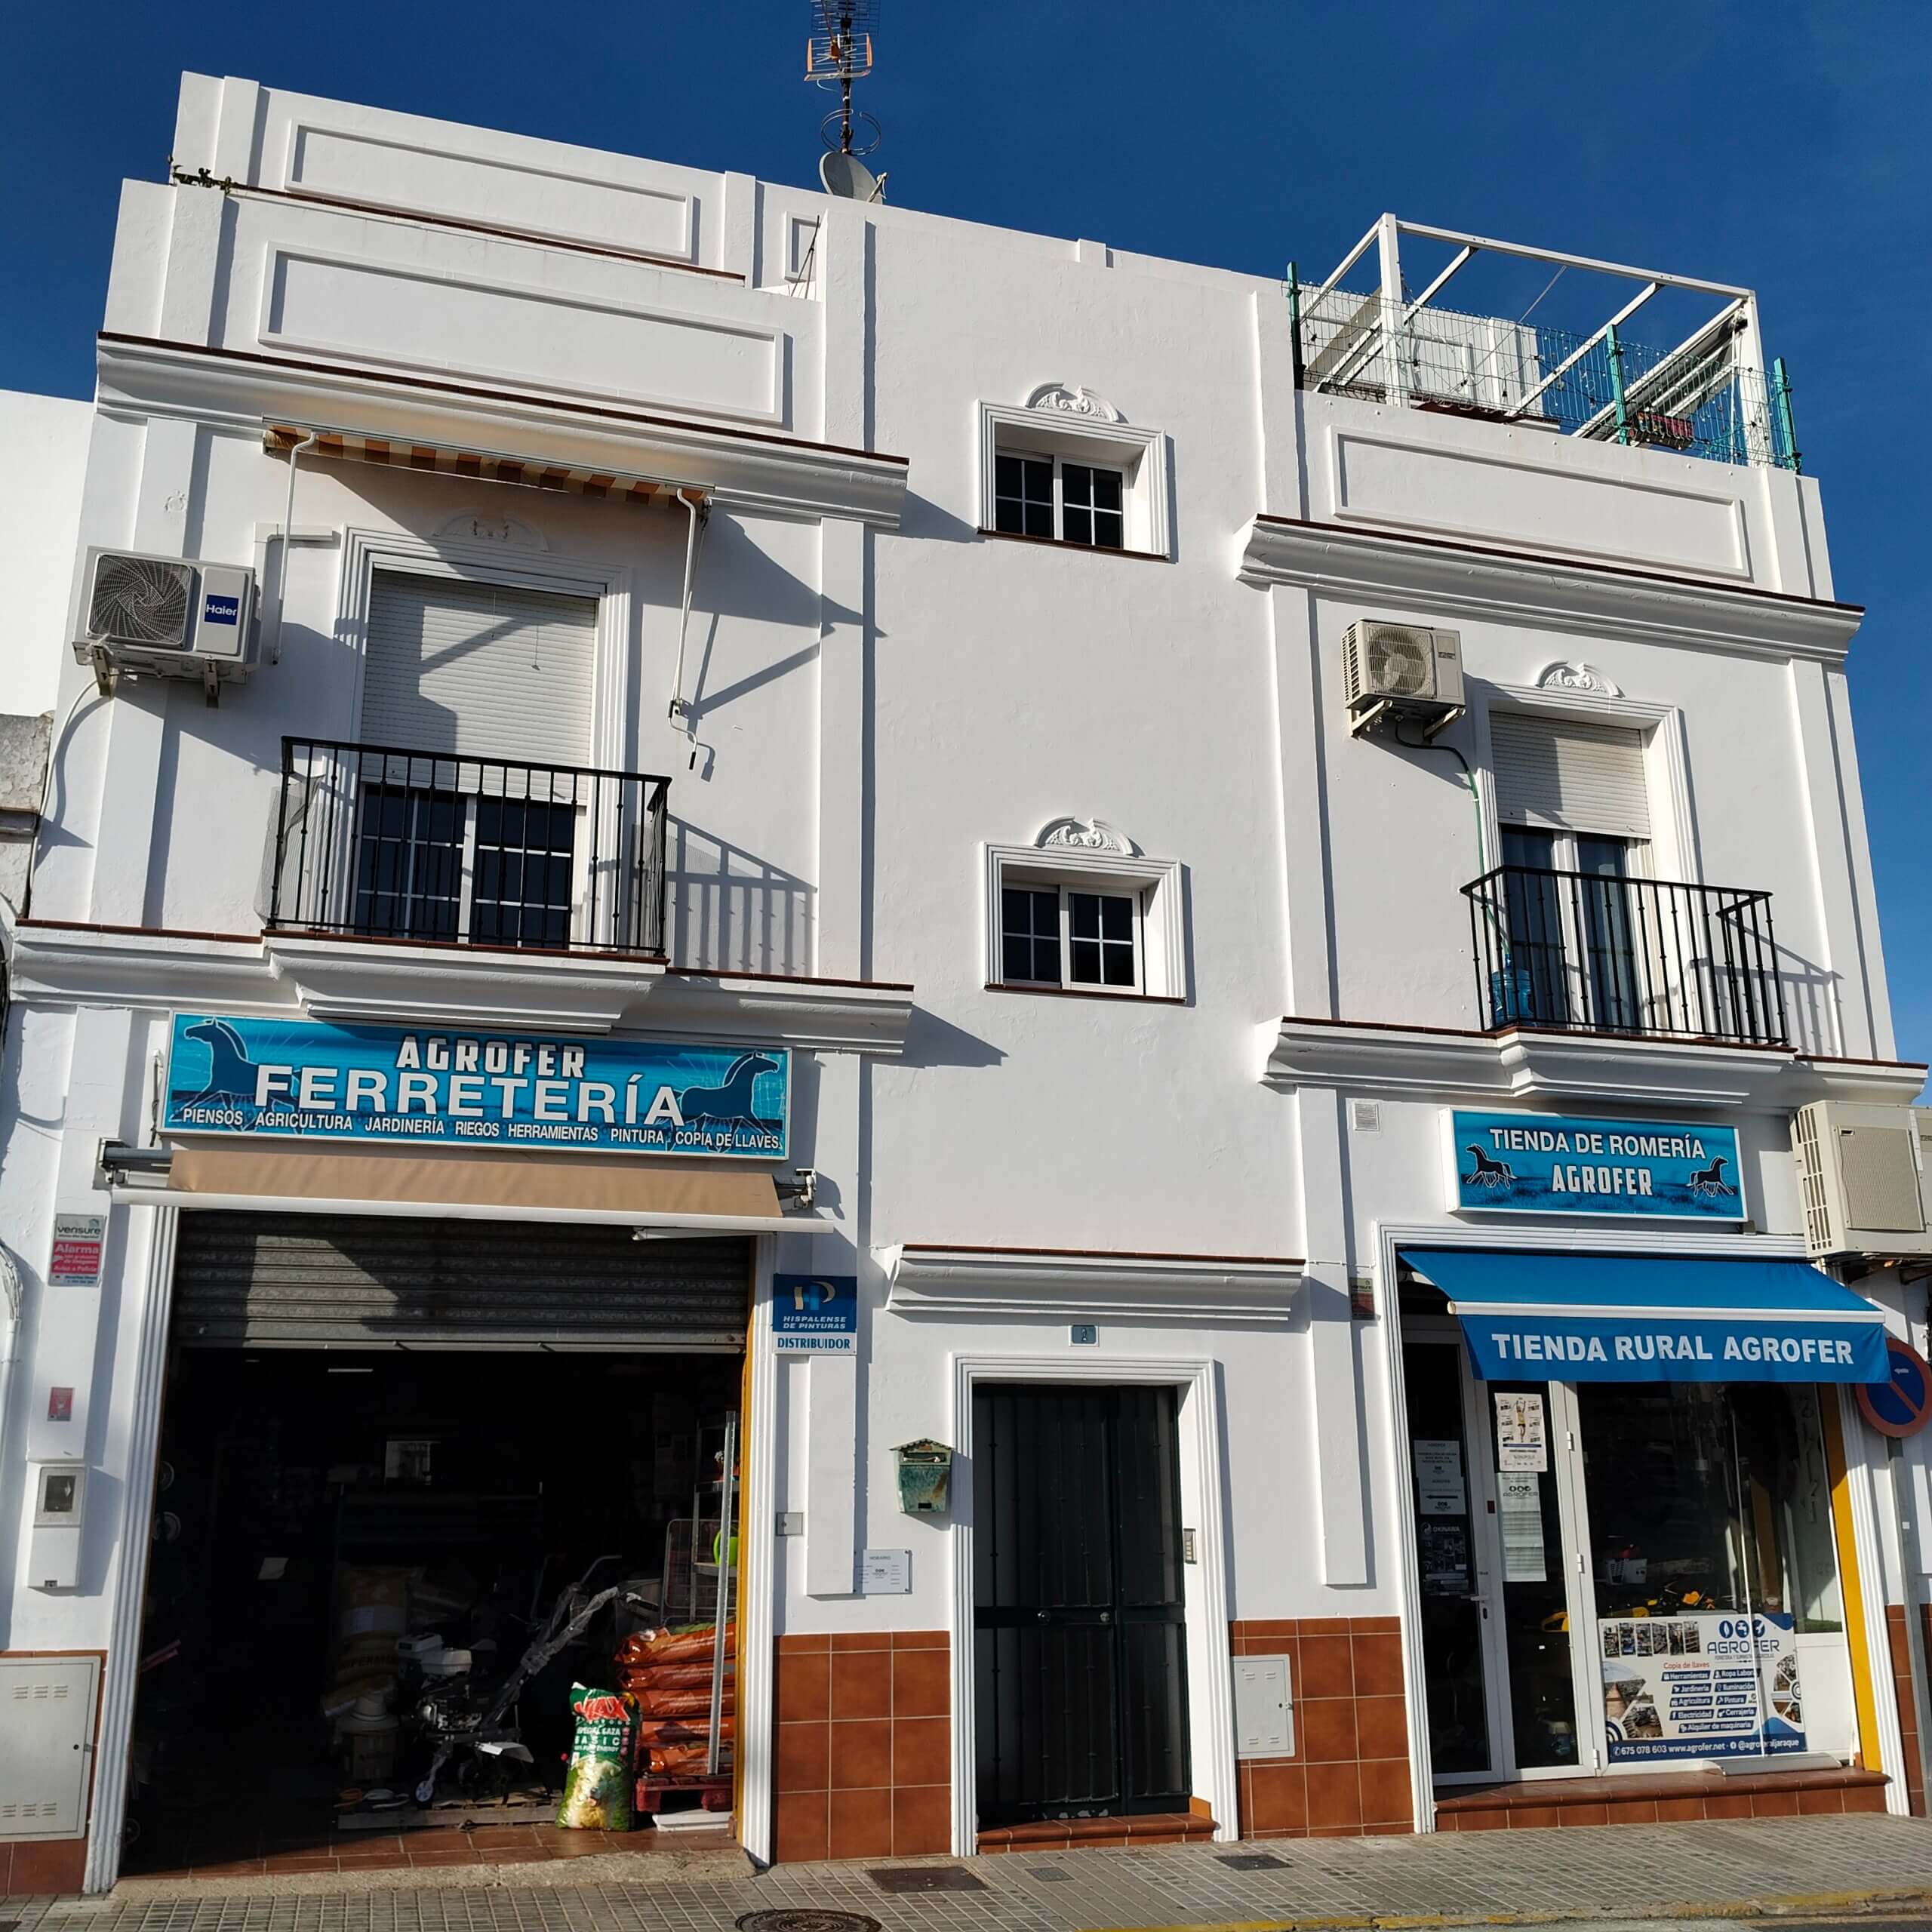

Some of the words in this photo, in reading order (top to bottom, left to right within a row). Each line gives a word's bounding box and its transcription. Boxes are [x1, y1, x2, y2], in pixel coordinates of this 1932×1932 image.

[205, 604, 237, 616] Haier
[396, 1036, 584, 1078] AGROFER
[254, 1064, 685, 1127] FERRETERÍA
[183, 1108, 244, 1125] PIENSOS
[254, 1111, 352, 1131] AGRICULTURA
[365, 1115, 445, 1134] JARDINERÍA
[454, 1120, 500, 1137] RIEGOS
[507, 1124, 598, 1142] HERRAMIENTAS
[611, 1128, 664, 1145] PINTURA
[675, 1131, 713, 1146] COPIA
[715, 1134, 731, 1147] DE
[734, 1134, 779, 1149] LLAVES
[1489, 1128, 1571, 1153] TIENDA
[1574, 1133, 1604, 1155] DE
[1609, 1133, 1706, 1160] ROMERÍA
[1552, 1164, 1654, 1197] AGROFER
[777, 1337, 851, 1349] DISTRIBUIDOR
[1491, 1333, 1607, 1362] TIENDA
[1614, 1335, 1713, 1361] RURAL
[1723, 1335, 1855, 1365] AGROFER
[1707, 1639, 1780, 1654] AGROFER
[1669, 1671, 1709, 1679] Herramientas
[1678, 1698, 1711, 1706] Agricultura
[1678, 1711, 1712, 1719] Electricidad
[1621, 1746, 1635, 1755] 675
[1636, 1746, 1651, 1754] 078
[1651, 1745, 1667, 1753] 603
[1668, 1742, 1726, 1754] www.agrofer.net
